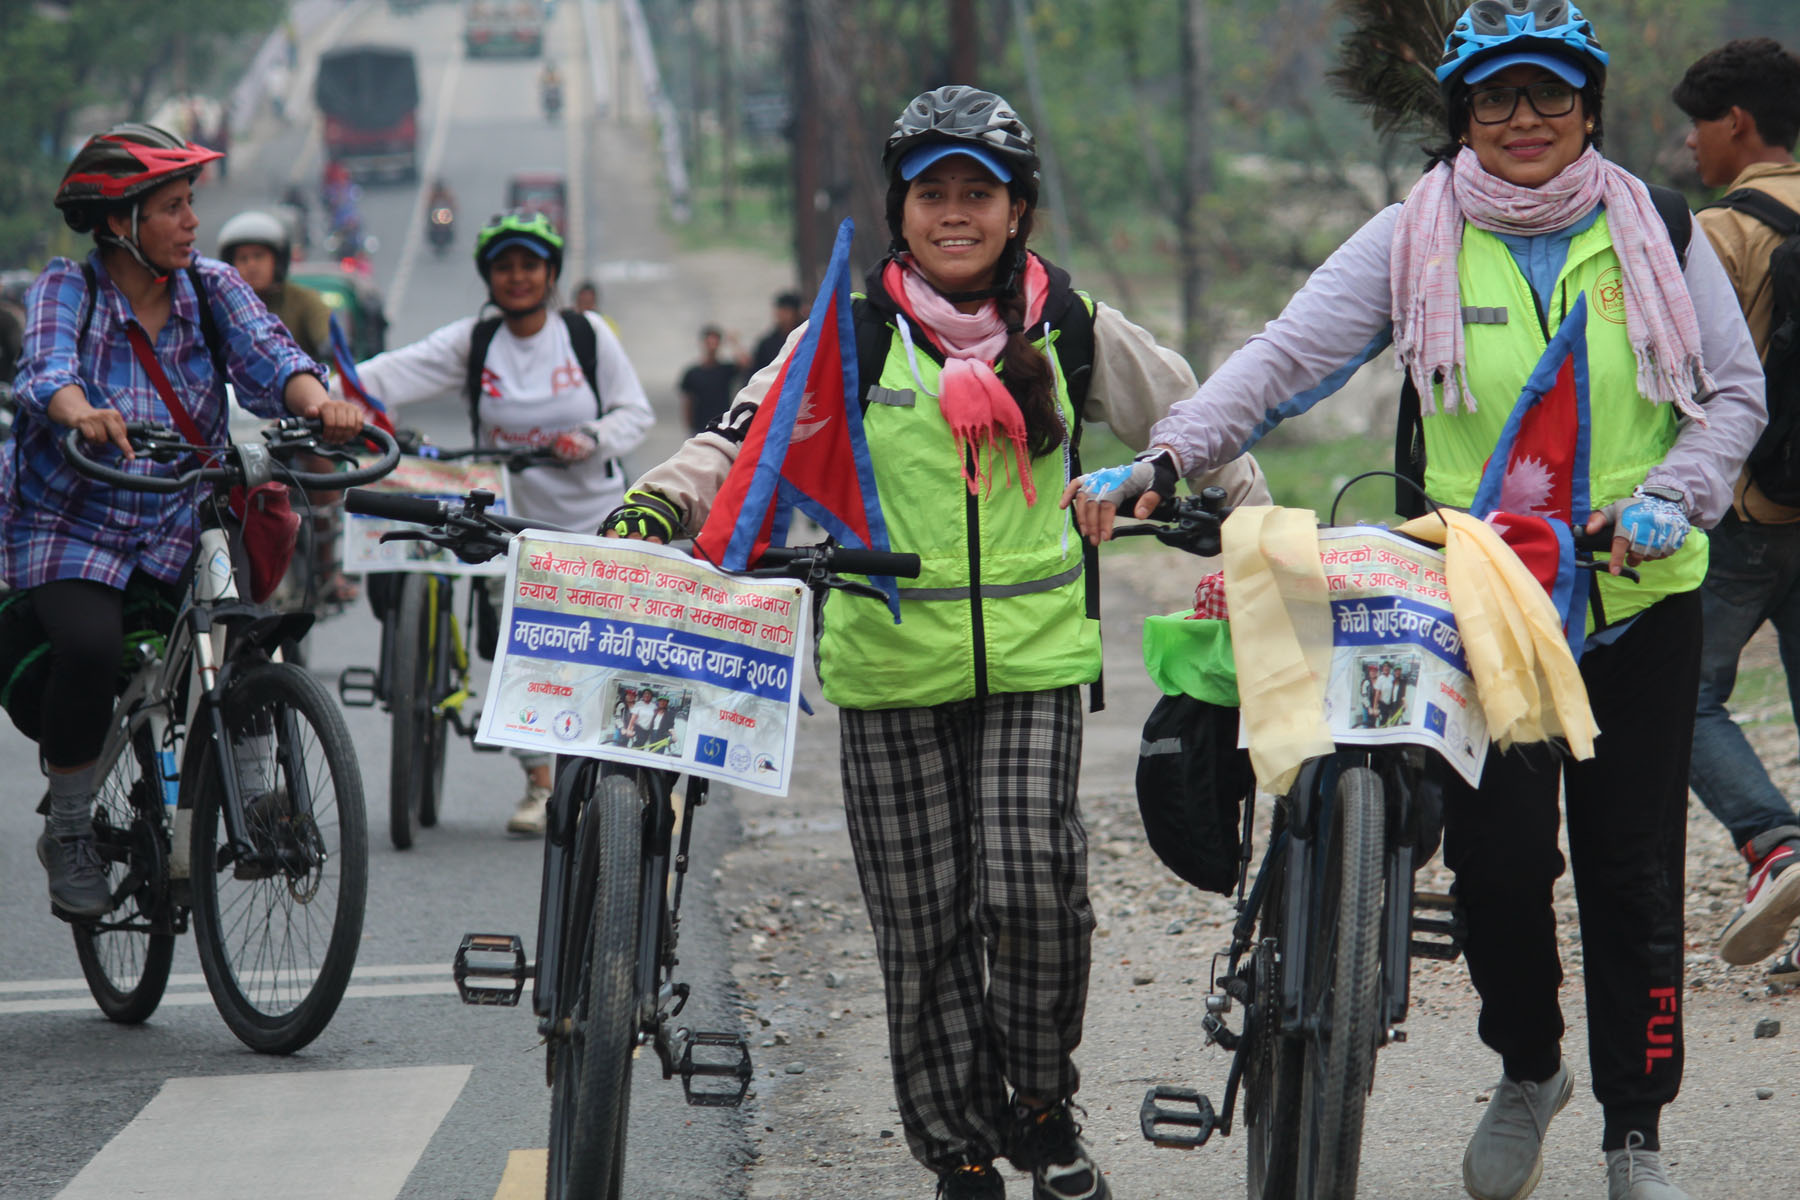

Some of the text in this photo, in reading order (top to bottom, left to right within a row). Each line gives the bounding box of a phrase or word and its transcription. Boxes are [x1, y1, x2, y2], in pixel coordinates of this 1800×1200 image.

[530, 552, 587, 577] सबैखाले
[591, 560, 650, 586] बिभेदको
[656, 572, 698, 596] अन्त्य
[701, 584, 729, 606] हाम्रो
[1368, 572, 1409, 592] आत्म
[519, 582, 794, 646] न्याय, समानता र आत्म सम्मानका लागि
[1338, 603, 1370, 633] मेची
[599, 624, 635, 659] मेची
[527, 680, 574, 697] आयोजक
[719, 709, 757, 729] प्रायोजक
